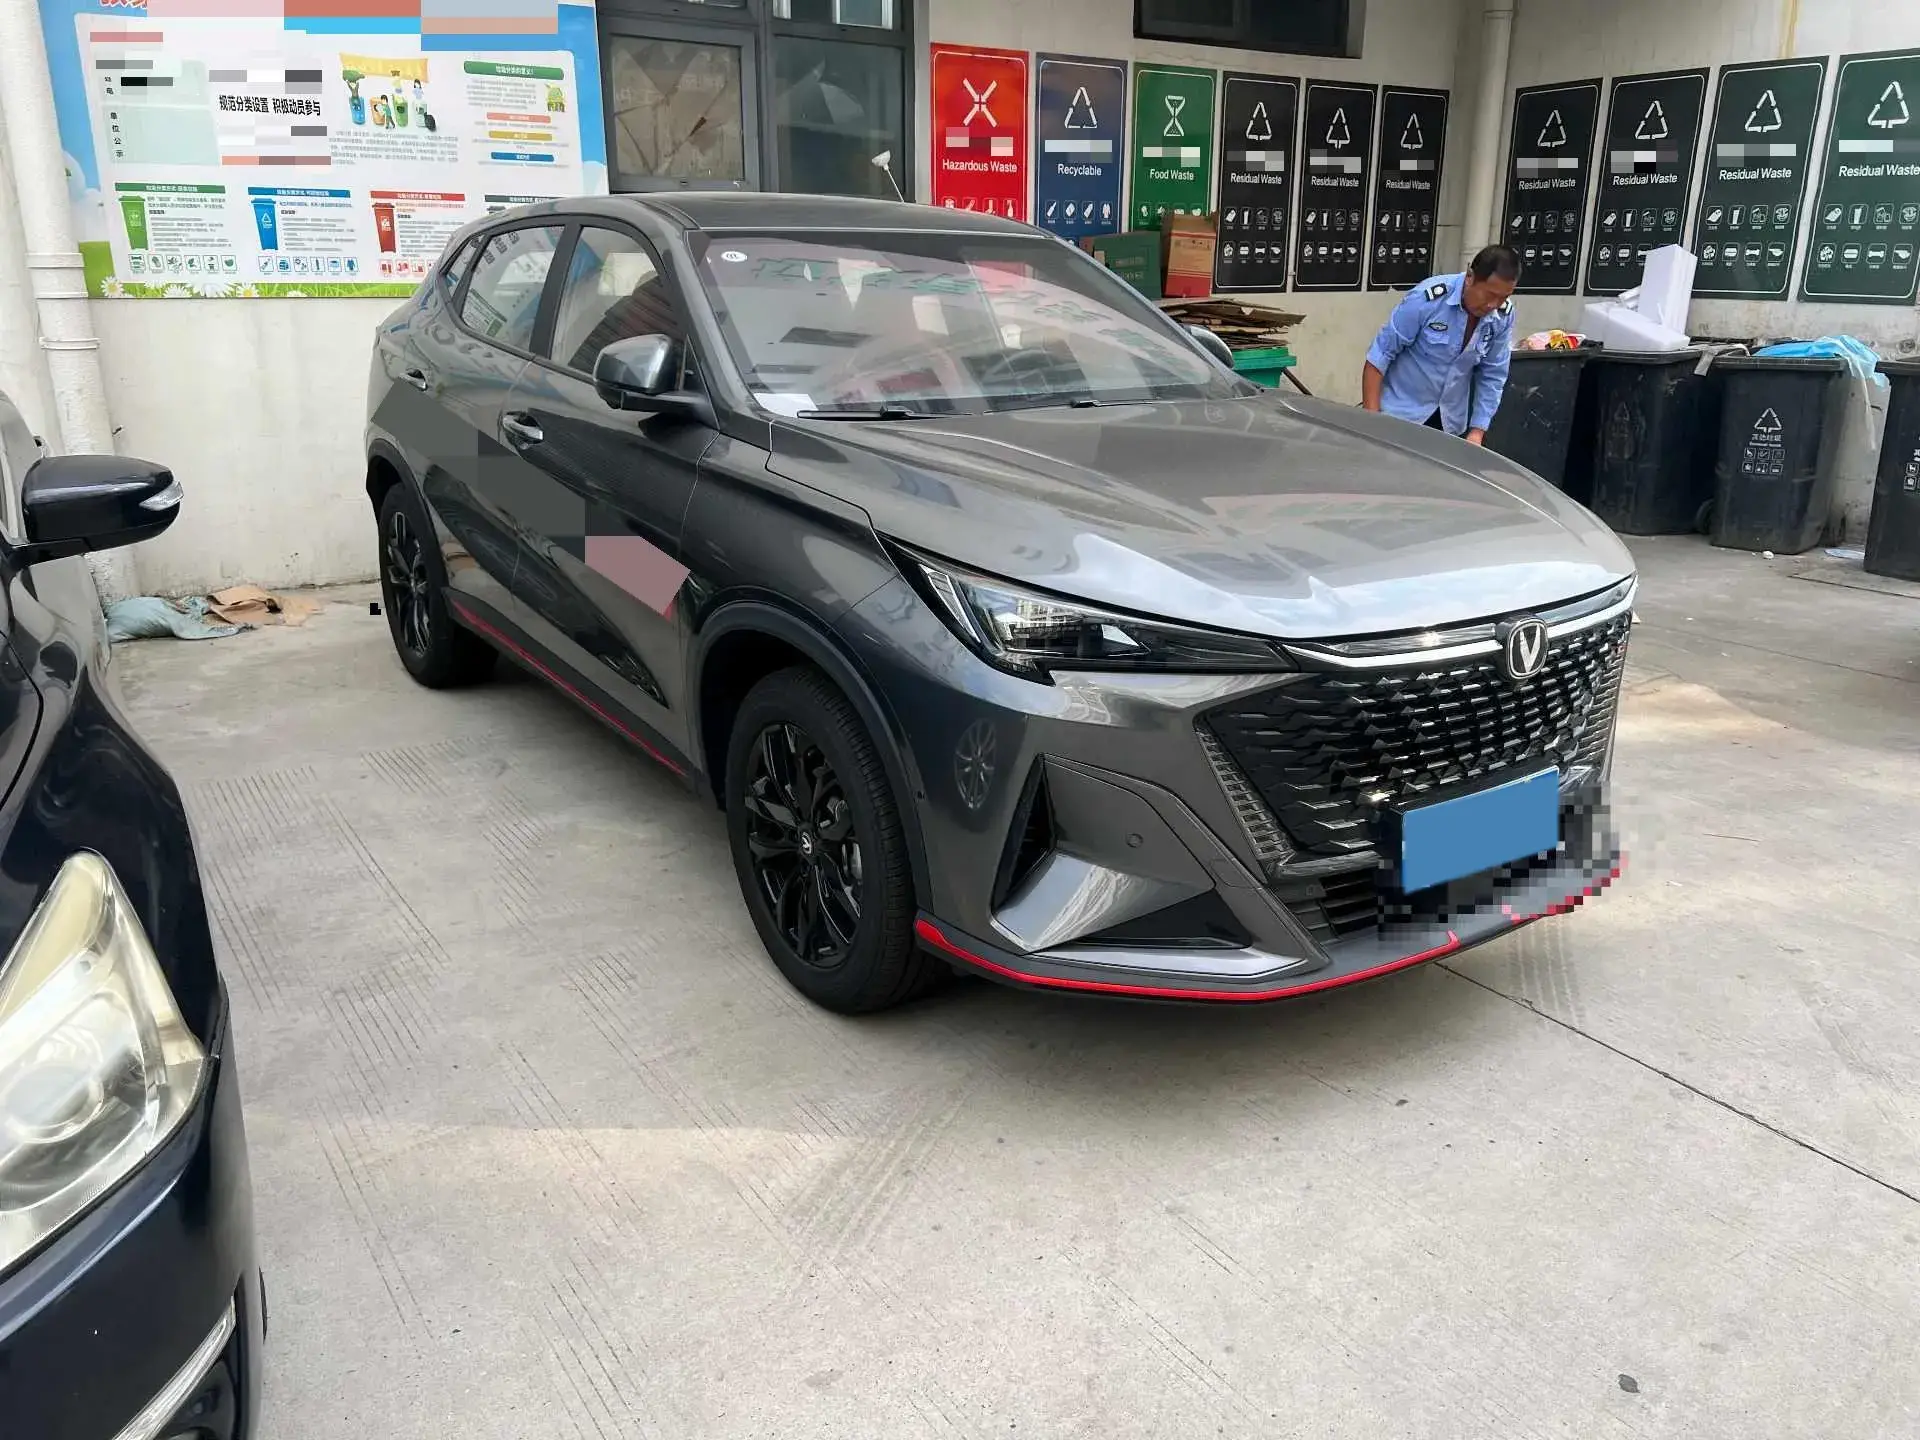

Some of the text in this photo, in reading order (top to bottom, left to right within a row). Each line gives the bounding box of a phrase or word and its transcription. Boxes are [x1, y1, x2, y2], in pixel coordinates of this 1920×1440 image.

[218, 94, 321, 117] 规范分类设置 积极动员参与
[942, 158, 1018, 173] Hazardous Waste
[1057, 163, 1102, 177] Recyclable
[1838, 163, 1920, 177] Residual Waste
[1150, 168, 1194, 181] Food Waste
[1231, 172, 1282, 185] Residual Waste
[1613, 173, 1678, 186] Residual Waste
[1719, 167, 1792, 181] Residual Waste
[1311, 175, 1359, 188] Residual Waste
[1386, 179, 1431, 190] Residual Waste
[1519, 177, 1576, 190] Residual Waste
